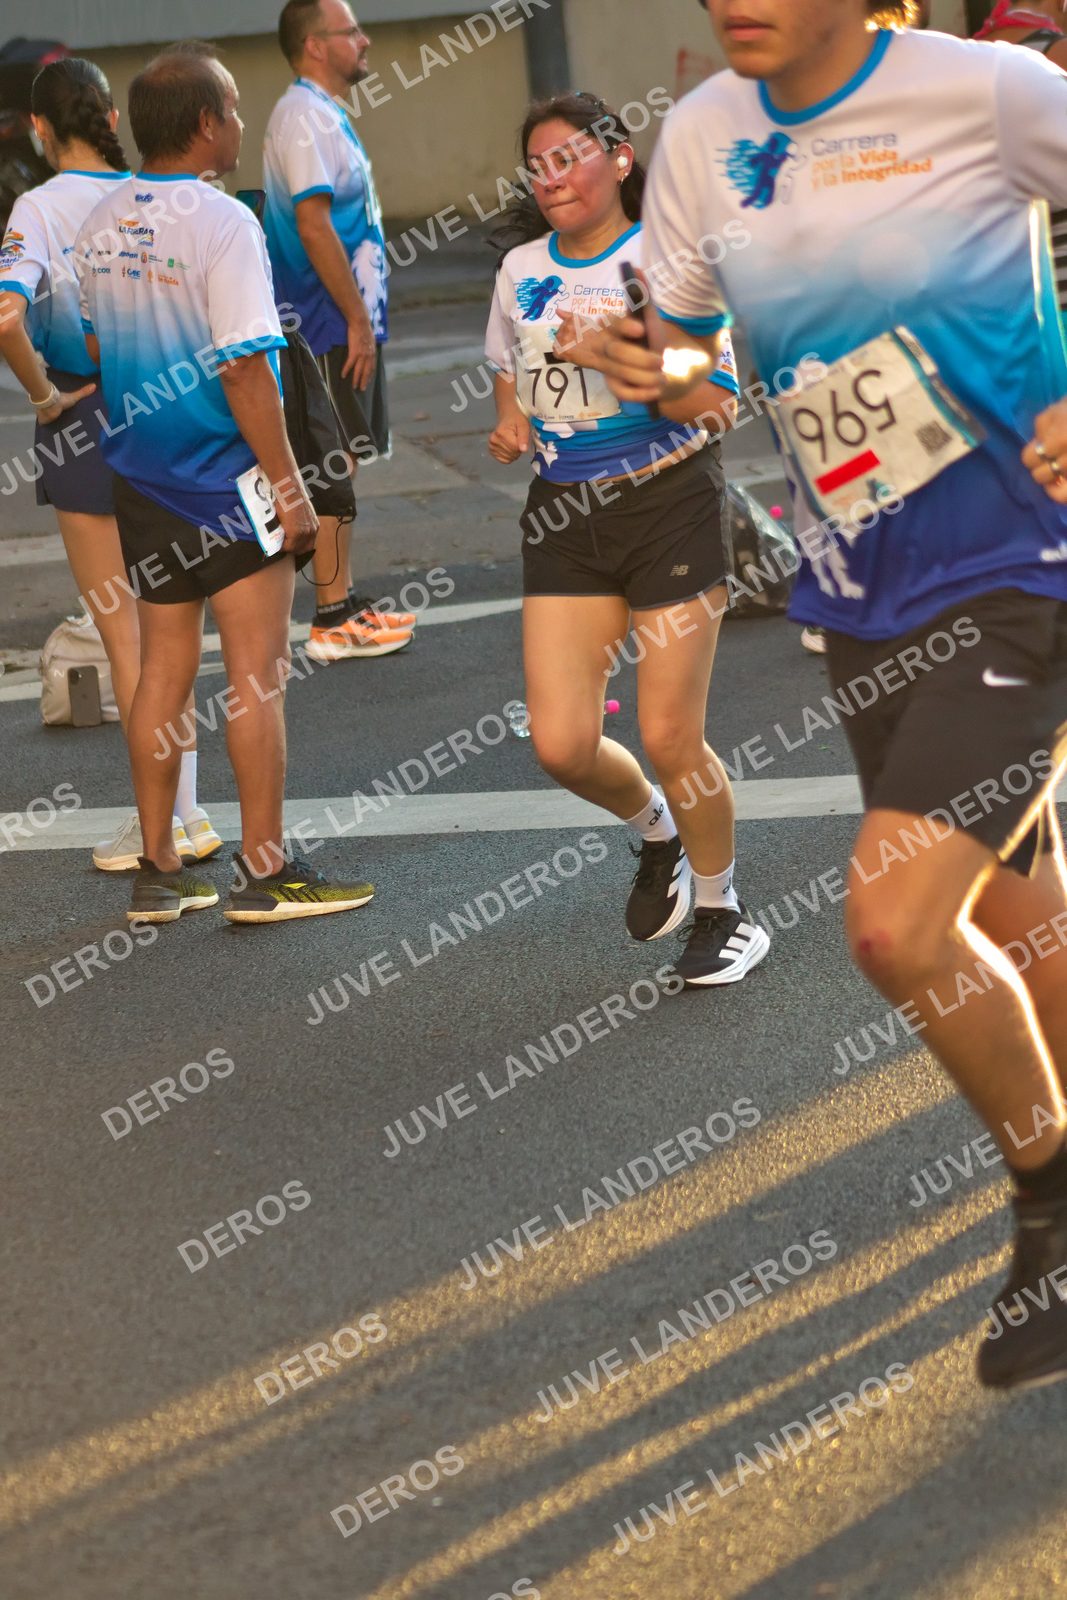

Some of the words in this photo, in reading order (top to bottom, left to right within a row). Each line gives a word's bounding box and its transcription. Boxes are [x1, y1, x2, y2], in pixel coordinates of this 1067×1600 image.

[812, 133, 898, 156] Carrera
[859, 149, 898, 165] Vida
[841, 156, 933, 183] Integridad
[573, 284, 624, 297] Carrera
[600, 297, 624, 307] Vida
[526, 366, 588, 409] 791
[648, 803, 664, 826] alo
